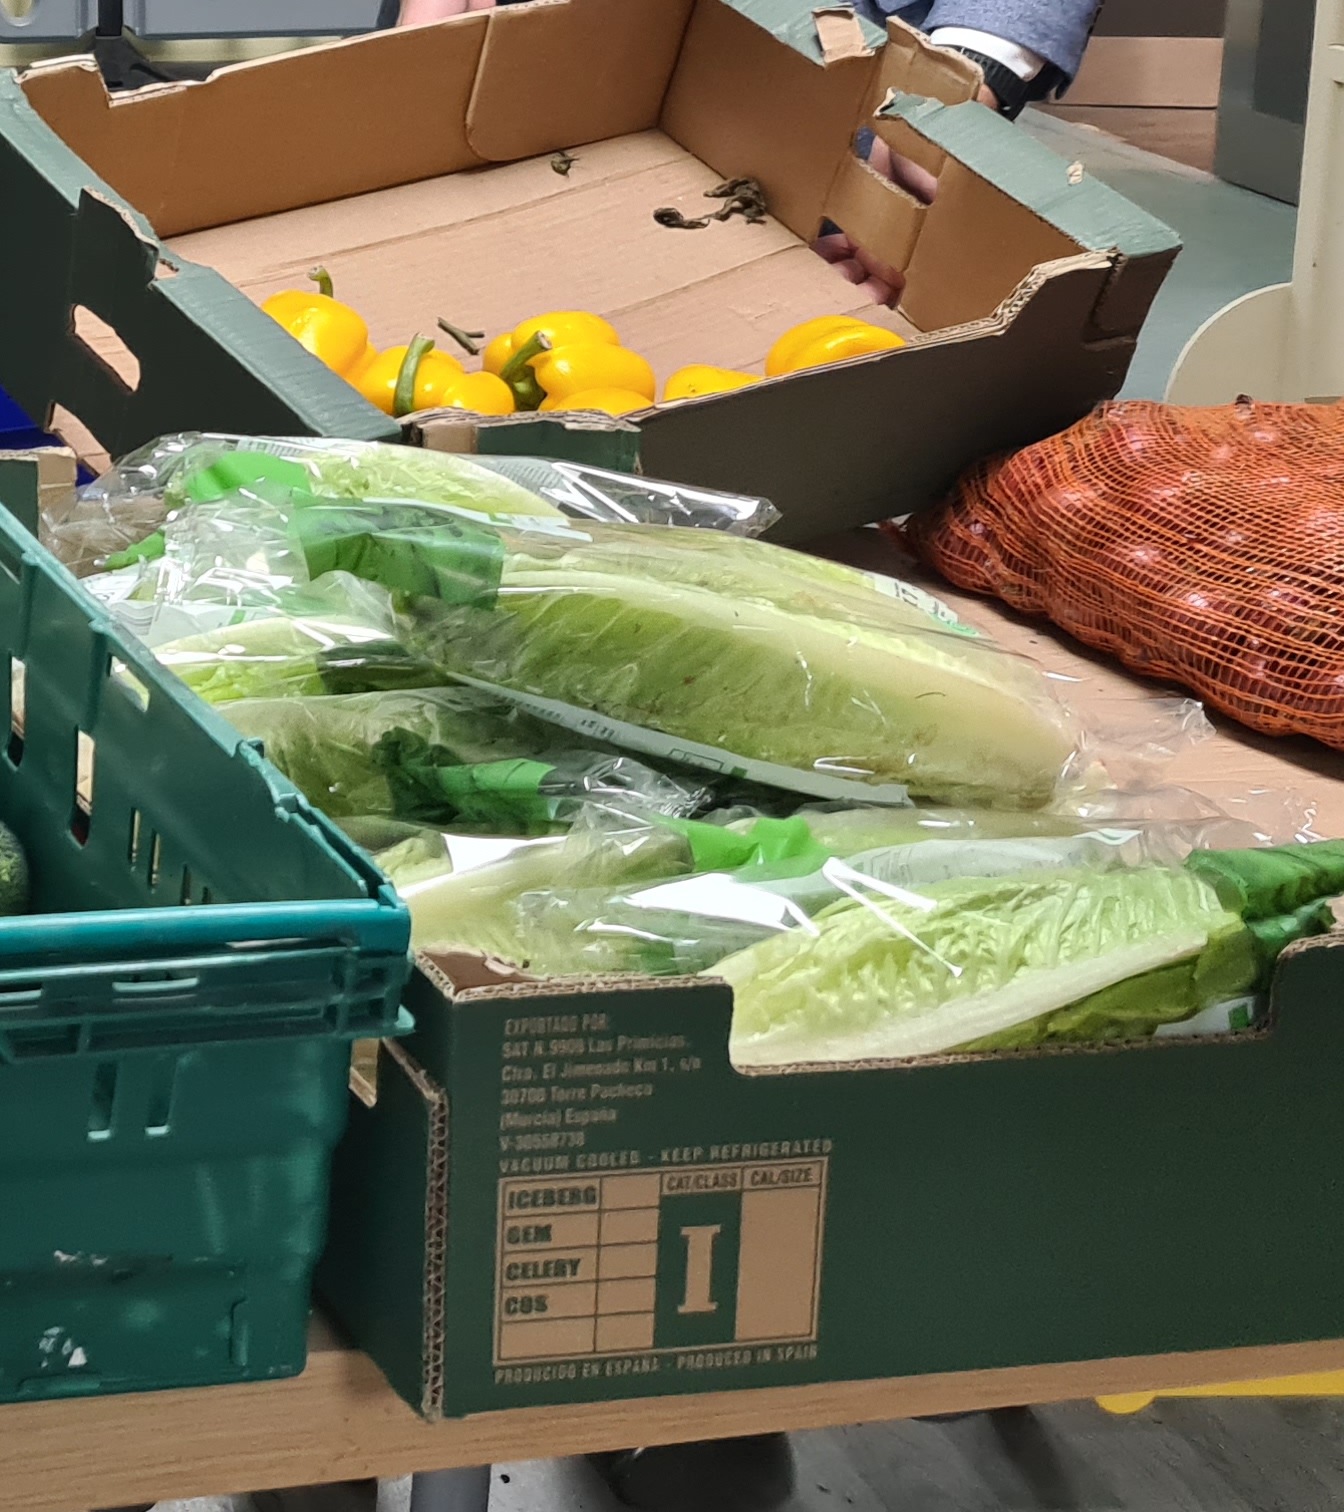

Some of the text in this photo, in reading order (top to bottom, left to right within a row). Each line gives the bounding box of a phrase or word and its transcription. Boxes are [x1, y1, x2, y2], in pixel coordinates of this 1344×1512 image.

[661, 1146, 704, 1163] KEEP
[710, 1139, 833, 1161] REFRIGERATED
[508, 1185, 597, 1209] ICEBERG
[505, 1258, 581, 1281] CELERY
